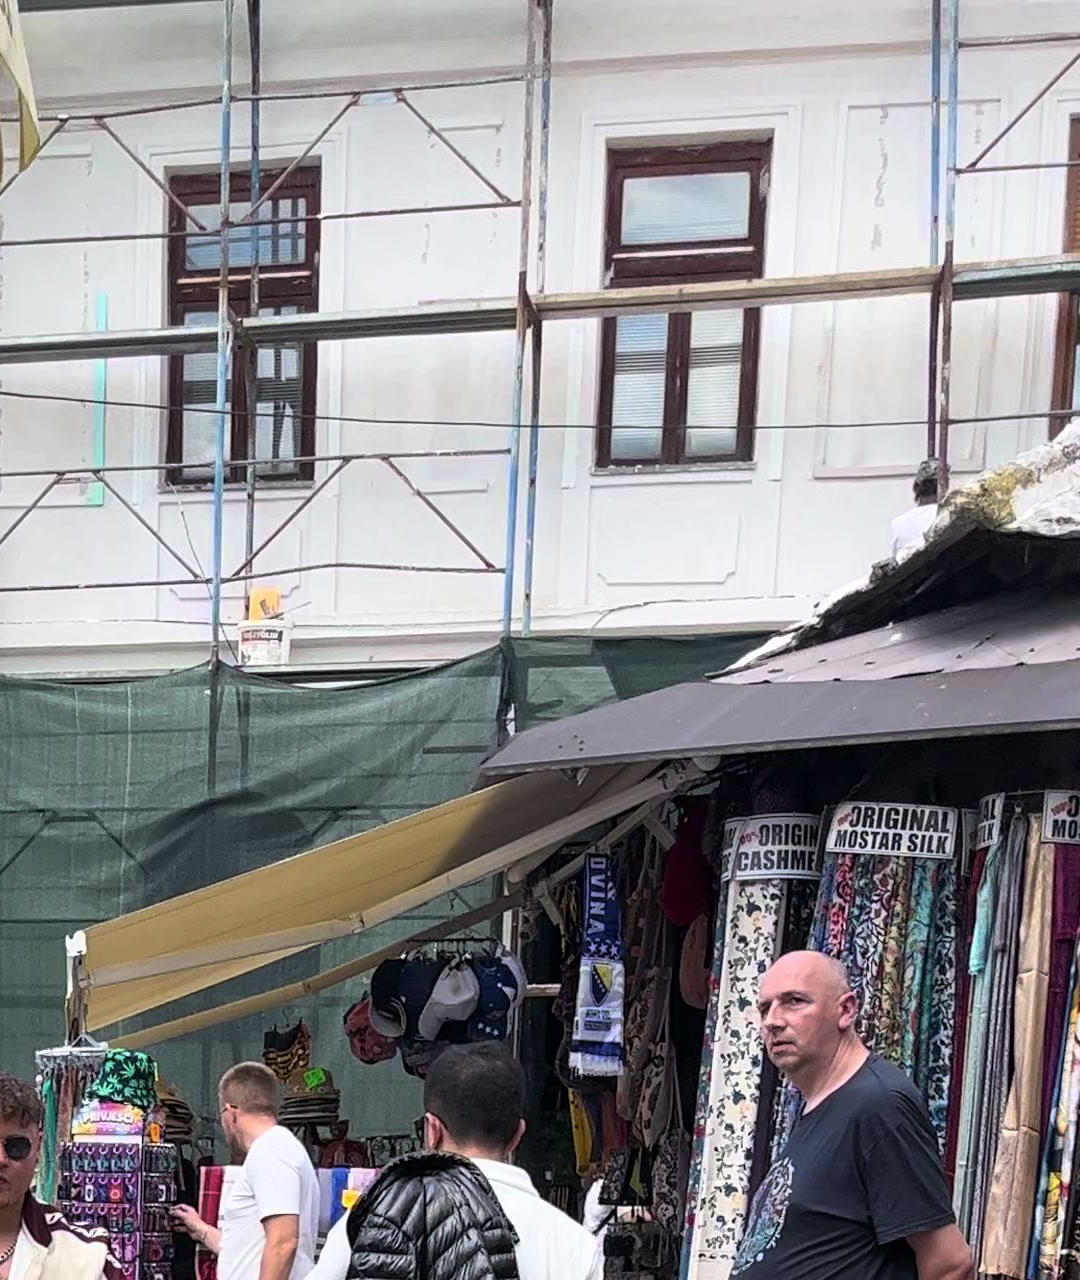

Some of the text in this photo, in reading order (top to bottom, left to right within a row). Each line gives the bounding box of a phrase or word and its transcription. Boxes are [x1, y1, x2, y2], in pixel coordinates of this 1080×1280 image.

[849, 805, 950, 834] ORIGINAL
[834, 829, 949, 854] MOSTAR SILK
